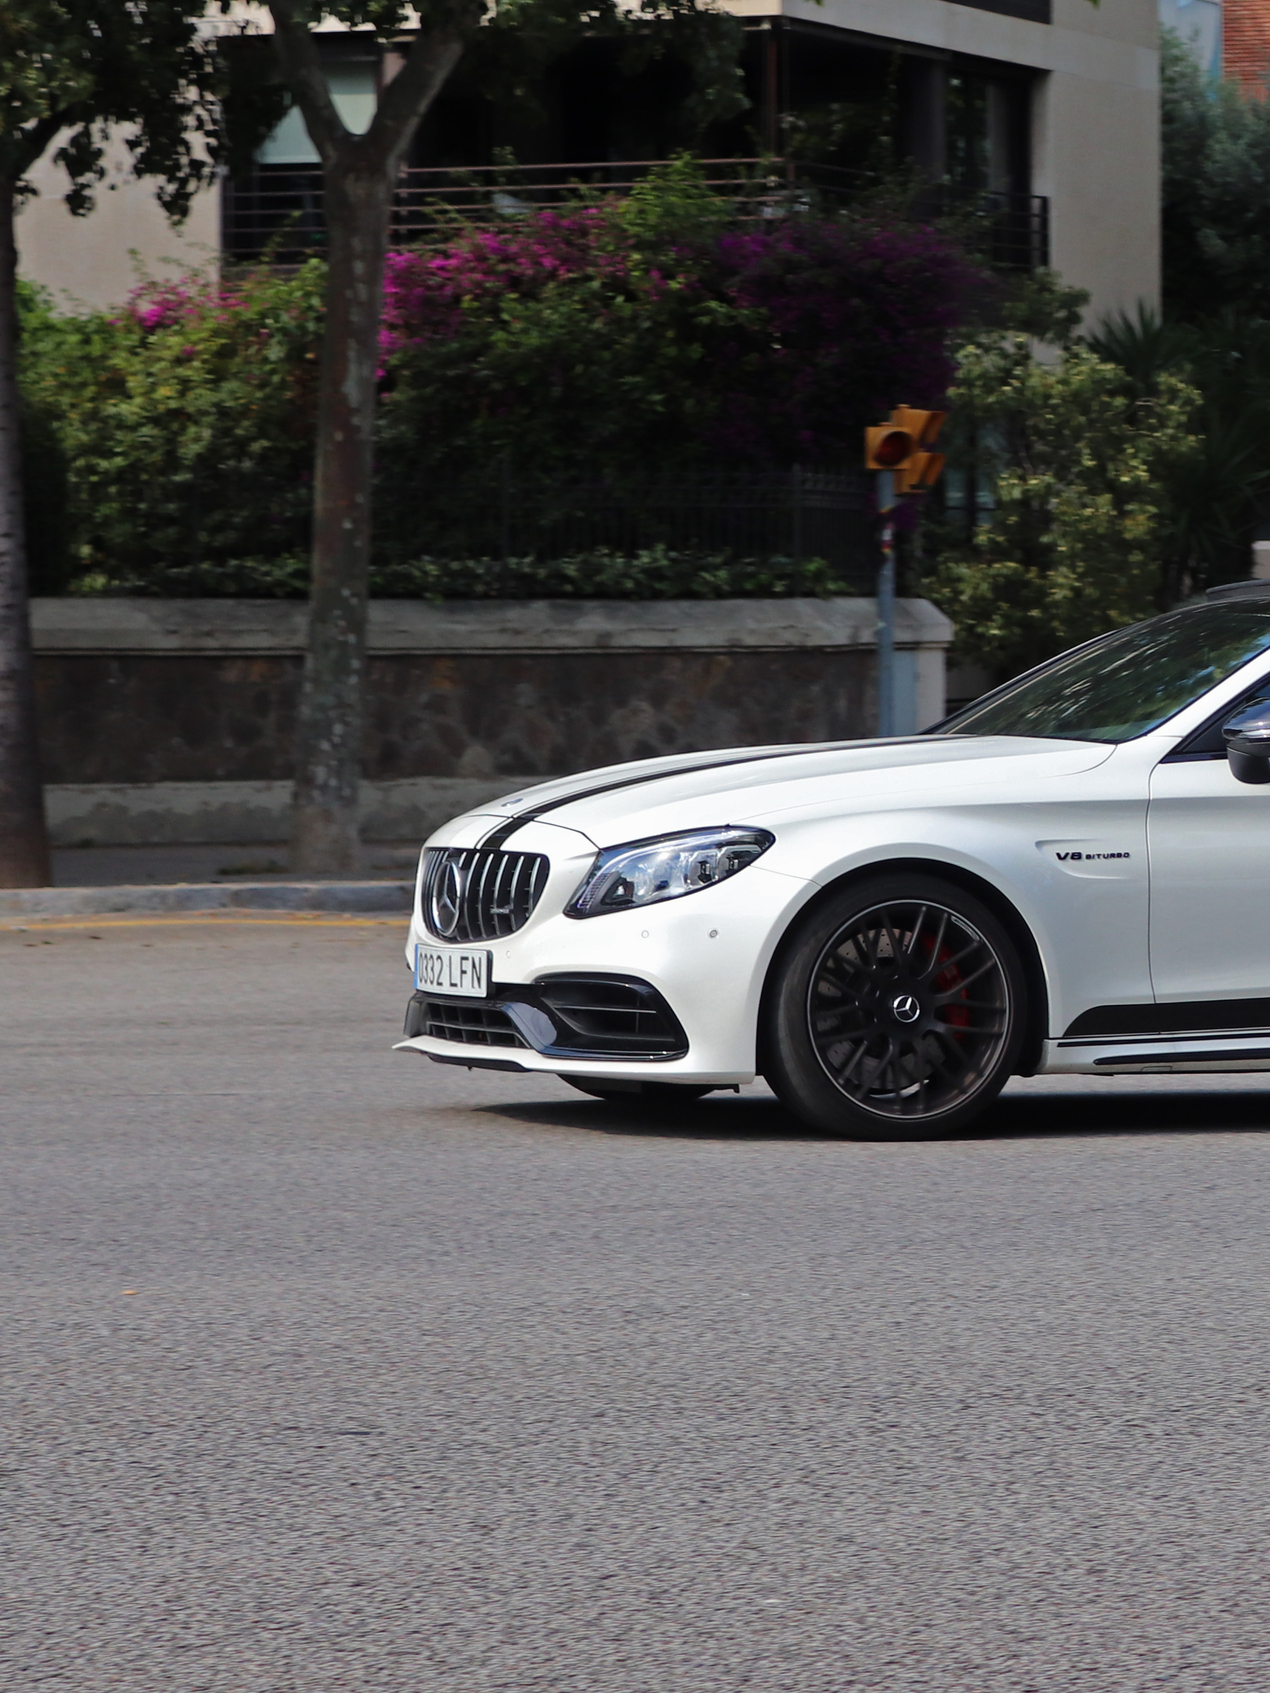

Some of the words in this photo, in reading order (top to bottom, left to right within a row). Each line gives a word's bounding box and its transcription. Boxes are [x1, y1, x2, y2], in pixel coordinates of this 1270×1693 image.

[1055, 851, 1083, 861] V8
[1085, 852, 1131, 860] BITURBO
[418, 952, 443, 987] 0332
[449, 955, 482, 989] LFN
